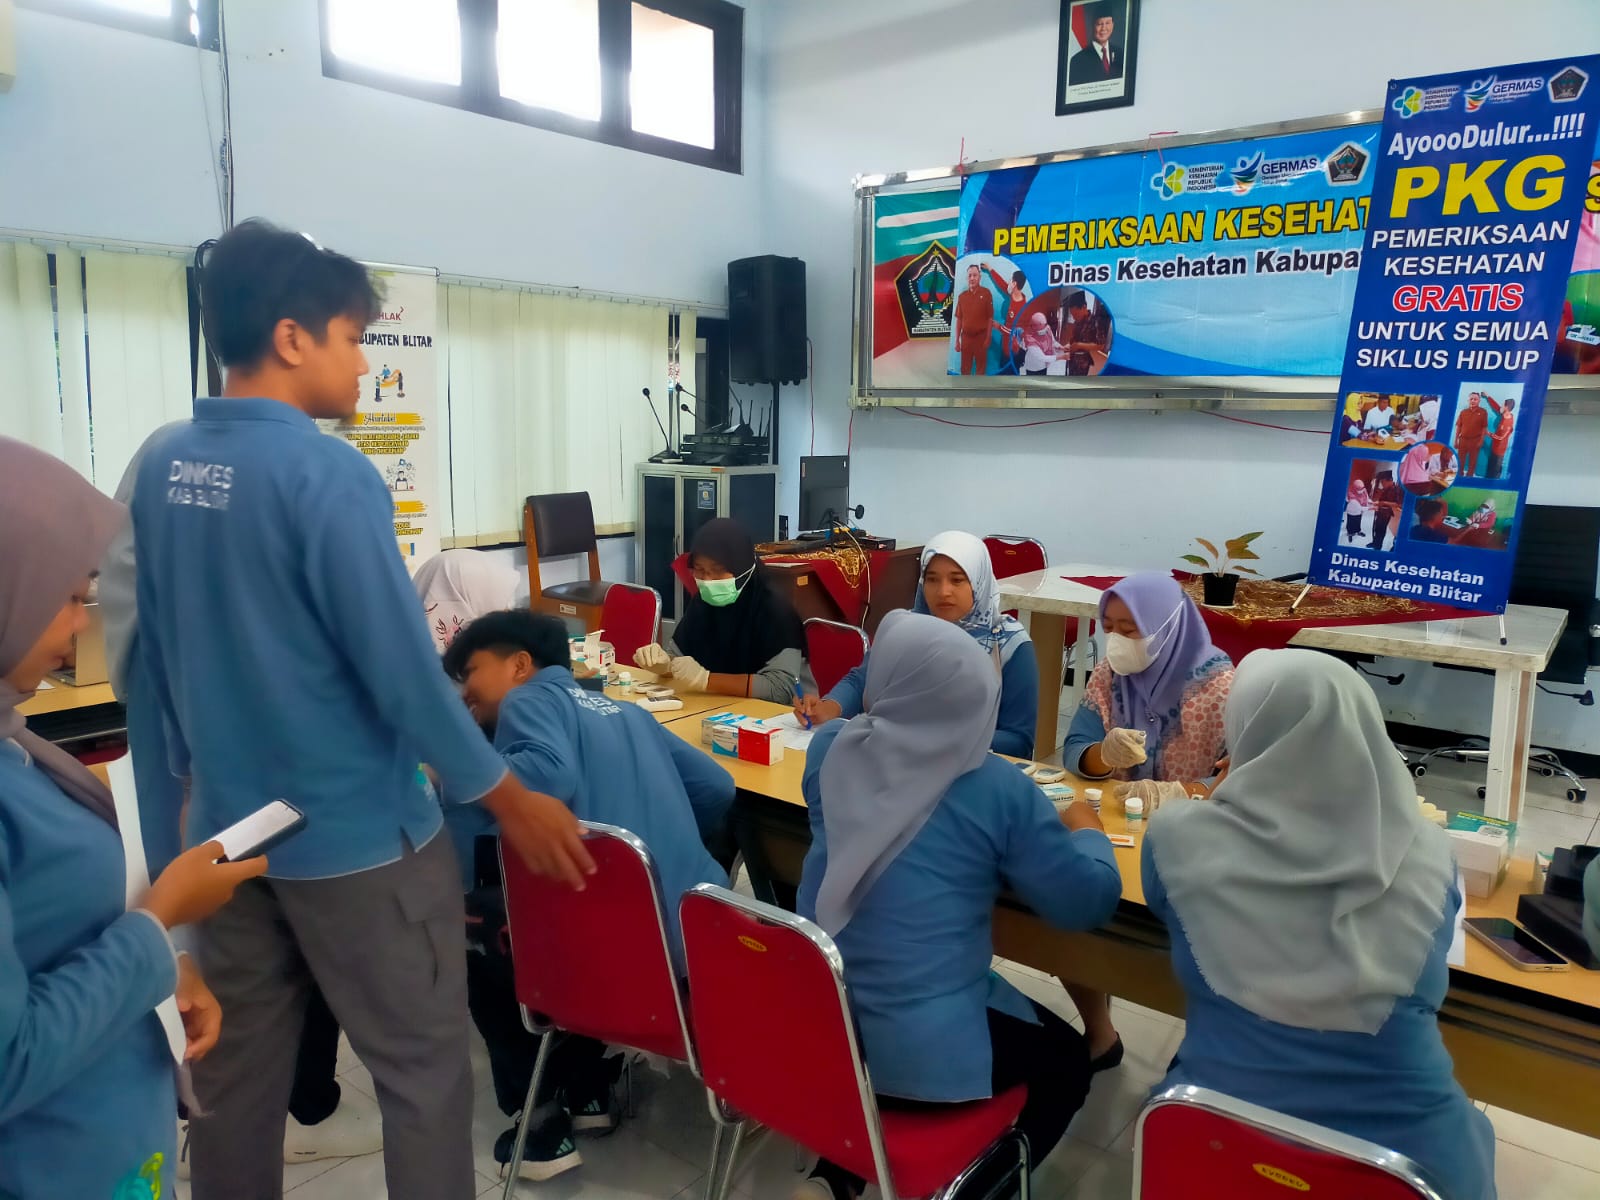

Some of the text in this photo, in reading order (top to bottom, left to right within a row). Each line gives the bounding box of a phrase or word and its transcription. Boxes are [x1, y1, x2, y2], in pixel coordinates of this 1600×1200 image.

[1492, 79, 1542, 94] GERMAS
[1261, 157, 1318, 174] GERMAS
[1389, 154, 1567, 219] PKG
[993, 211, 1205, 256] PEMERIKSAAN
[1213, 195, 1372, 240] KESEHAT
[1371, 219, 1570, 249] PEMERIKSAAN
[1049, 248, 1359, 284] Dinas Kesehatan Kabupa
[1384, 252, 1545, 277] KESEHATAN
[1392, 283, 1524, 312] GRATIS
[402, 334, 433, 347] BLITAR
[1357, 321, 1447, 341] UNTUK
[1453, 320, 1549, 342] SEMUA
[1356, 348, 1540, 371] SIKLUS HIDUP
[168, 460, 235, 489] DINKES
[1330, 552, 1485, 586] Dinas Kesehatan
[1327, 569, 1483, 603] Kabupaten Blitar
